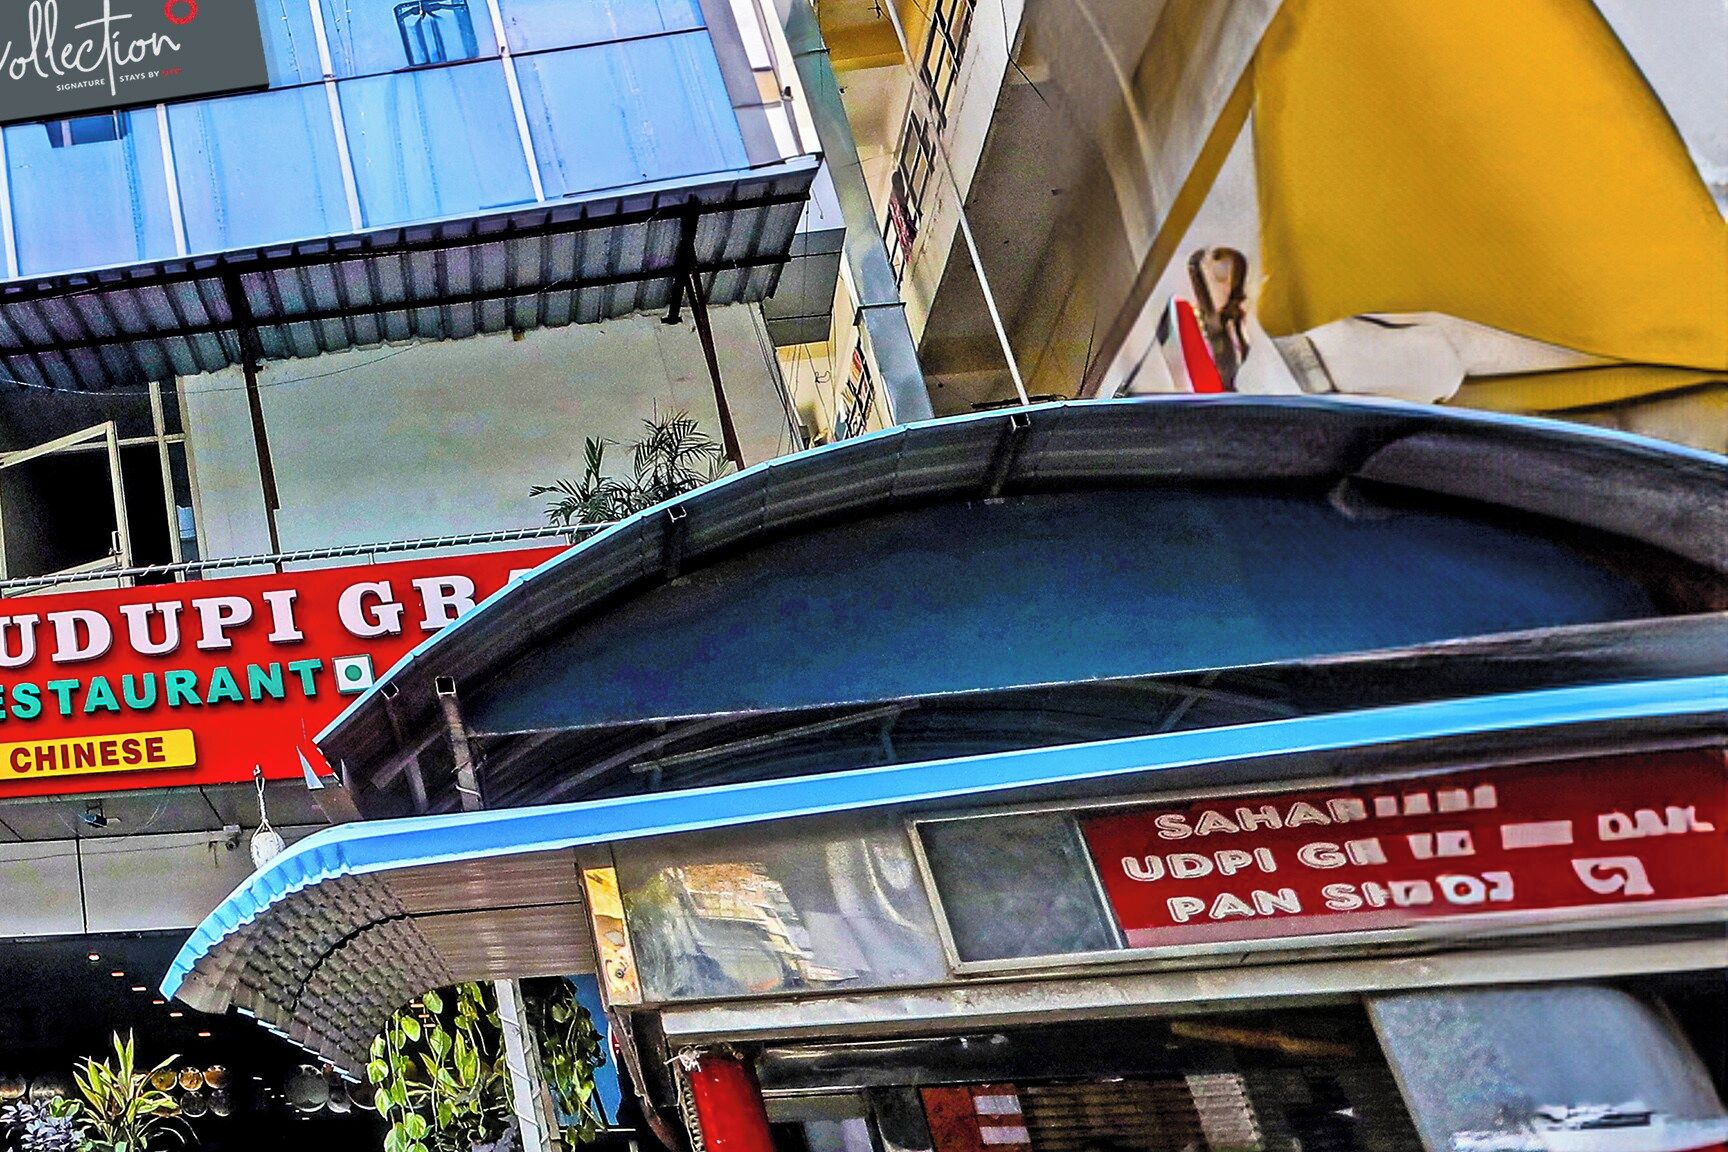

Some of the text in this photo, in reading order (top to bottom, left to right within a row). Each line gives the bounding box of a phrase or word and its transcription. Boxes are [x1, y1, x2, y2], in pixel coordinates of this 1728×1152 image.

[56, 78, 106, 92] SIGNATURE
[119, 73, 146, 83] STAYS
[148, 70, 160, 79] BY
[338, 566, 533, 636] GR
[9, 736, 167, 774] CHINESE
[1121, 847, 1277, 882] UDPI
[1167, 888, 1302, 923] PAN
